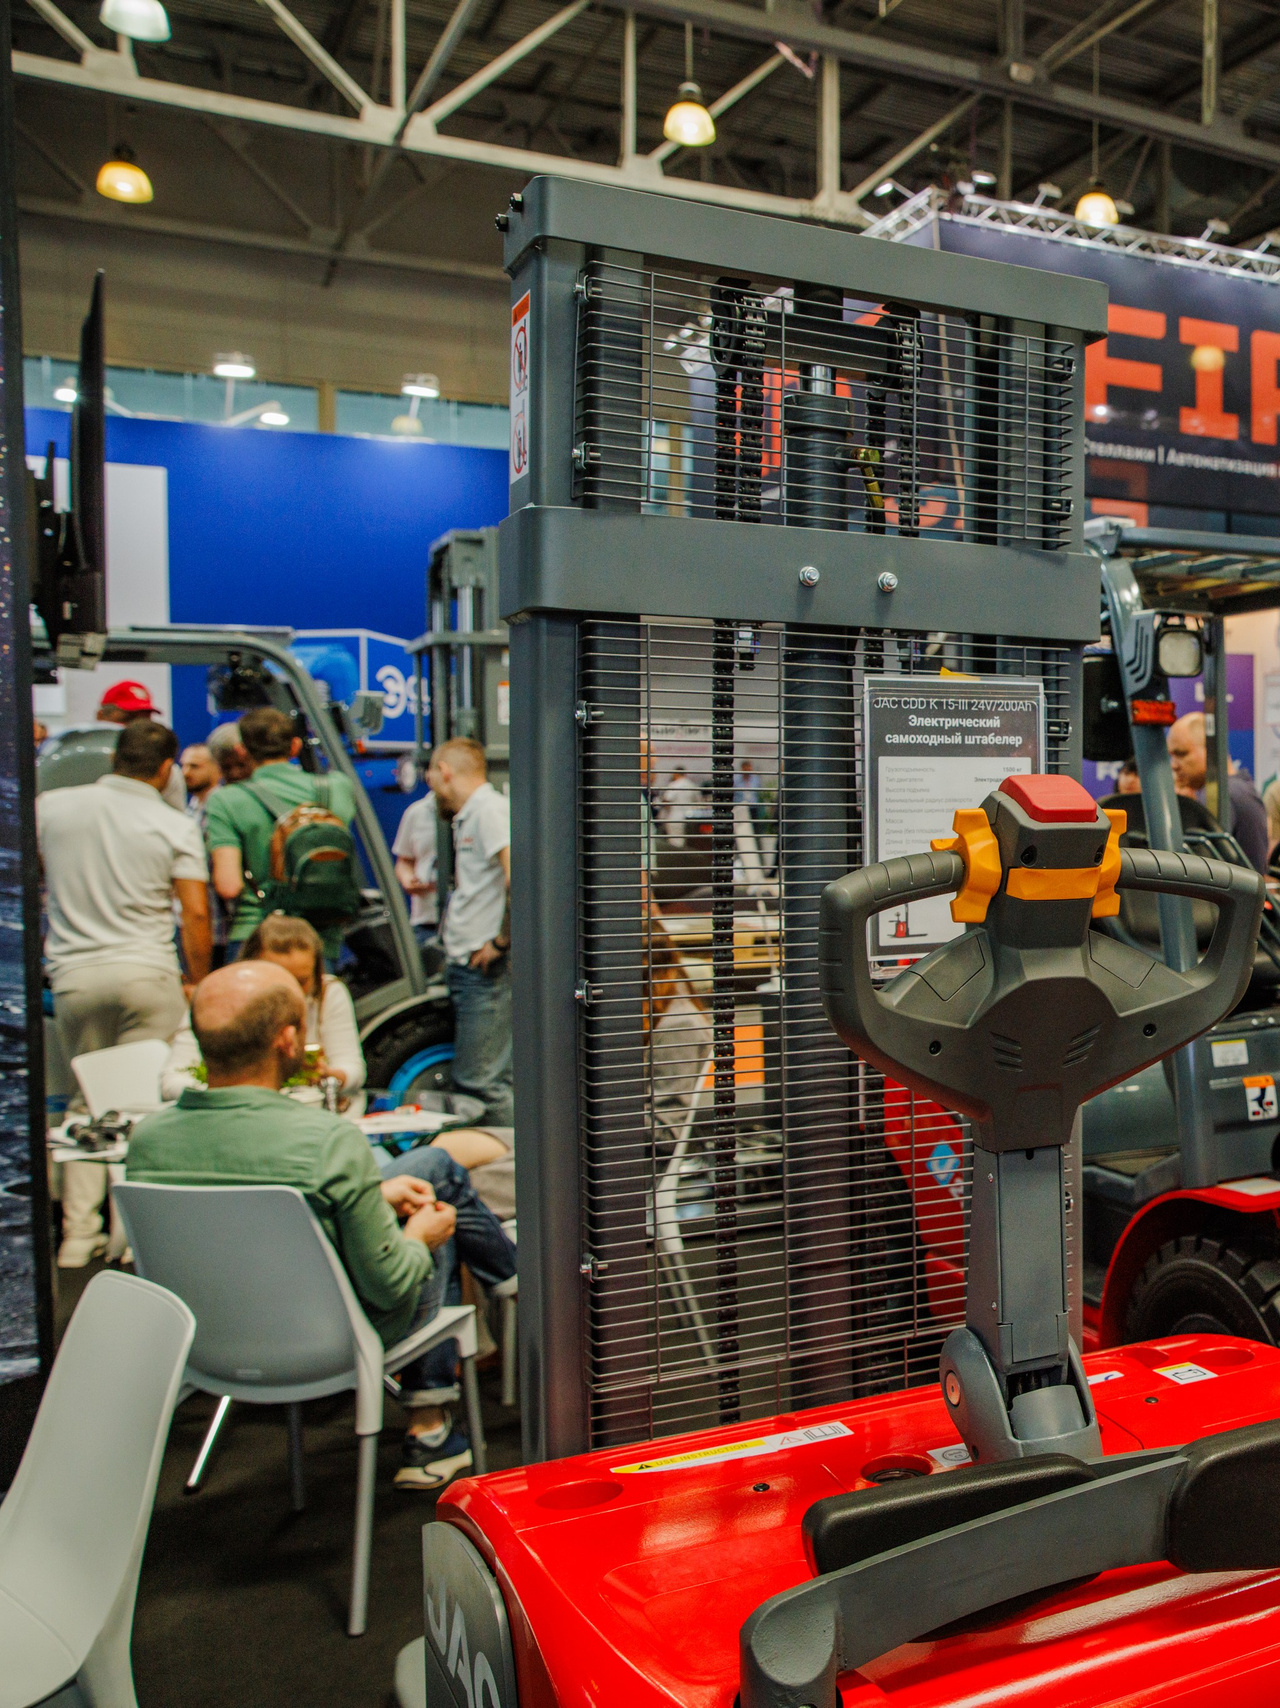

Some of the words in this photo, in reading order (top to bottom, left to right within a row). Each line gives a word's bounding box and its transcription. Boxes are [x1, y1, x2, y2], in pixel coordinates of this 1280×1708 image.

[873, 697, 899, 709] JAC
[901, 698, 926, 710] CDD
[930, 699, 938, 710] K
[971, 700, 1032, 712] 24V/200Ah
[908, 714, 1001, 729] Электрический
[885, 732, 962, 747] самоходный
[964, 732, 1023, 747] штабелер
[680, 1443, 748, 1461] INSTRUCTION
